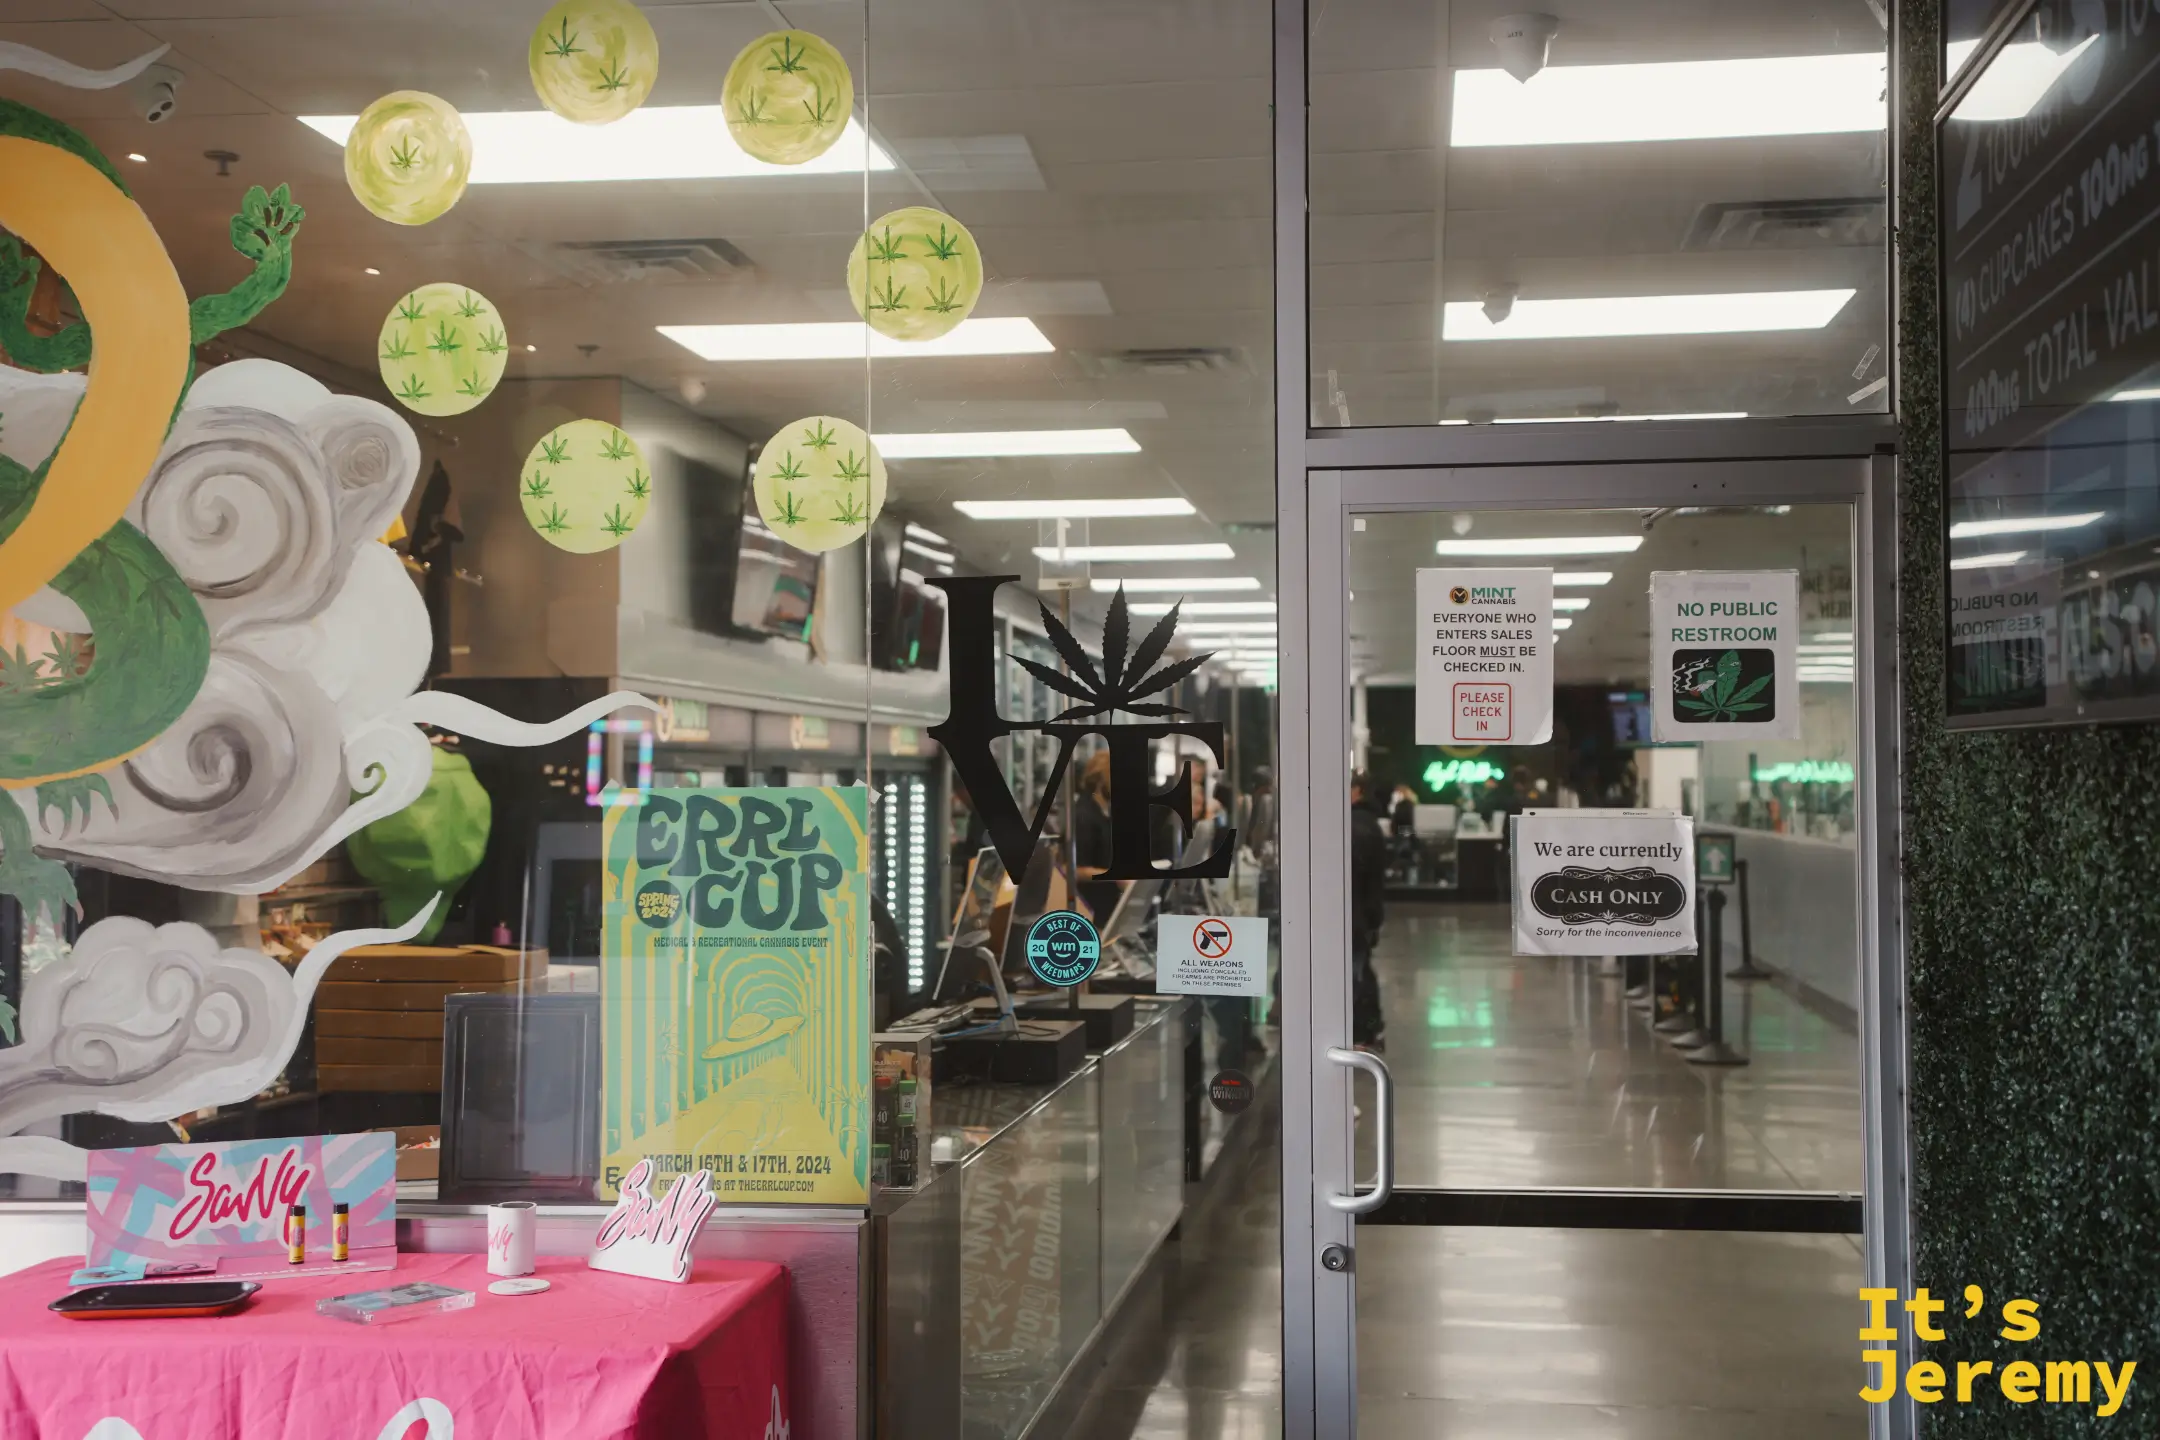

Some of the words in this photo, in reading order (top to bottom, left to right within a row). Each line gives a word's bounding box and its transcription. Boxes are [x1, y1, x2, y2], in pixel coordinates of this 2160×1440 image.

[1979, 185, 2075, 314] CUPCAKES
[2080, 134, 2149, 228] 100MG
[2025, 302, 2098, 401] TOTAL
[2104, 259, 2160, 350] VAL
[1471, 587, 1517, 598] MINT
[1677, 602, 1705, 618] NO
[1710, 601, 1778, 617] PUBLIC
[1433, 613, 1503, 623] EVERYONE
[1506, 613, 1537, 623] WHO
[1436, 629, 1487, 640] ENTERS
[1491, 629, 1533, 640] SALES
[1671, 626, 1777, 642] RESTROOM
[1432, 646, 1476, 656] FLOOR
[1480, 646, 1516, 657] MUST
[1519, 646, 1537, 656] BE
[1443, 662, 1506, 673] CHECKED
[1509, 662, 1525, 673] IN.
[1460, 692, 1505, 703] PLEASE
[1462, 706, 1502, 717] CHECK
[1476, 720, 1488, 731] IN
[636, 794, 821, 877] ERRL
[1534, 841, 1562, 857] We
[1567, 844, 1595, 857] are
[1599, 842, 1683, 862] currently
[686, 853, 843, 931] CUP
[1550, 888, 1603, 904] CASH
[1609, 888, 1663, 905] ONLY
[638, 892, 680, 909] SPRING
[641, 904, 675, 919] 2024
[1047, 919, 1068, 932] BEST
[1070, 921, 1081, 932] OF
[1536, 927, 1565, 938] Sorry
[1567, 927, 1583, 937] for
[1585, 927, 1601, 937] the
[1604, 928, 1682, 938] inconvenience
[653, 936, 689, 948] MEDICAL
[698, 936, 758, 948] RECREATIONAL
[760, 937, 800, 948] CANNABIS
[802, 937, 828, 948] EVENT
[1032, 944, 1045, 953] 20
[1051, 942, 1076, 951] wm
[1041, 961, 1085, 979] WEEDMAPS
[1200, 960, 1244, 968] WEAPONS
[643, 1154, 693, 1173] ARCH
[699, 1154, 734, 1173] 16TH
[739, 1155, 748, 1173] &
[753, 1155, 792, 1175] 17TH,
[796, 1155, 832, 1174] 2024
[724, 1180, 736, 1191] AT
[739, 1179, 814, 1193] THEERRLCUP.COM
